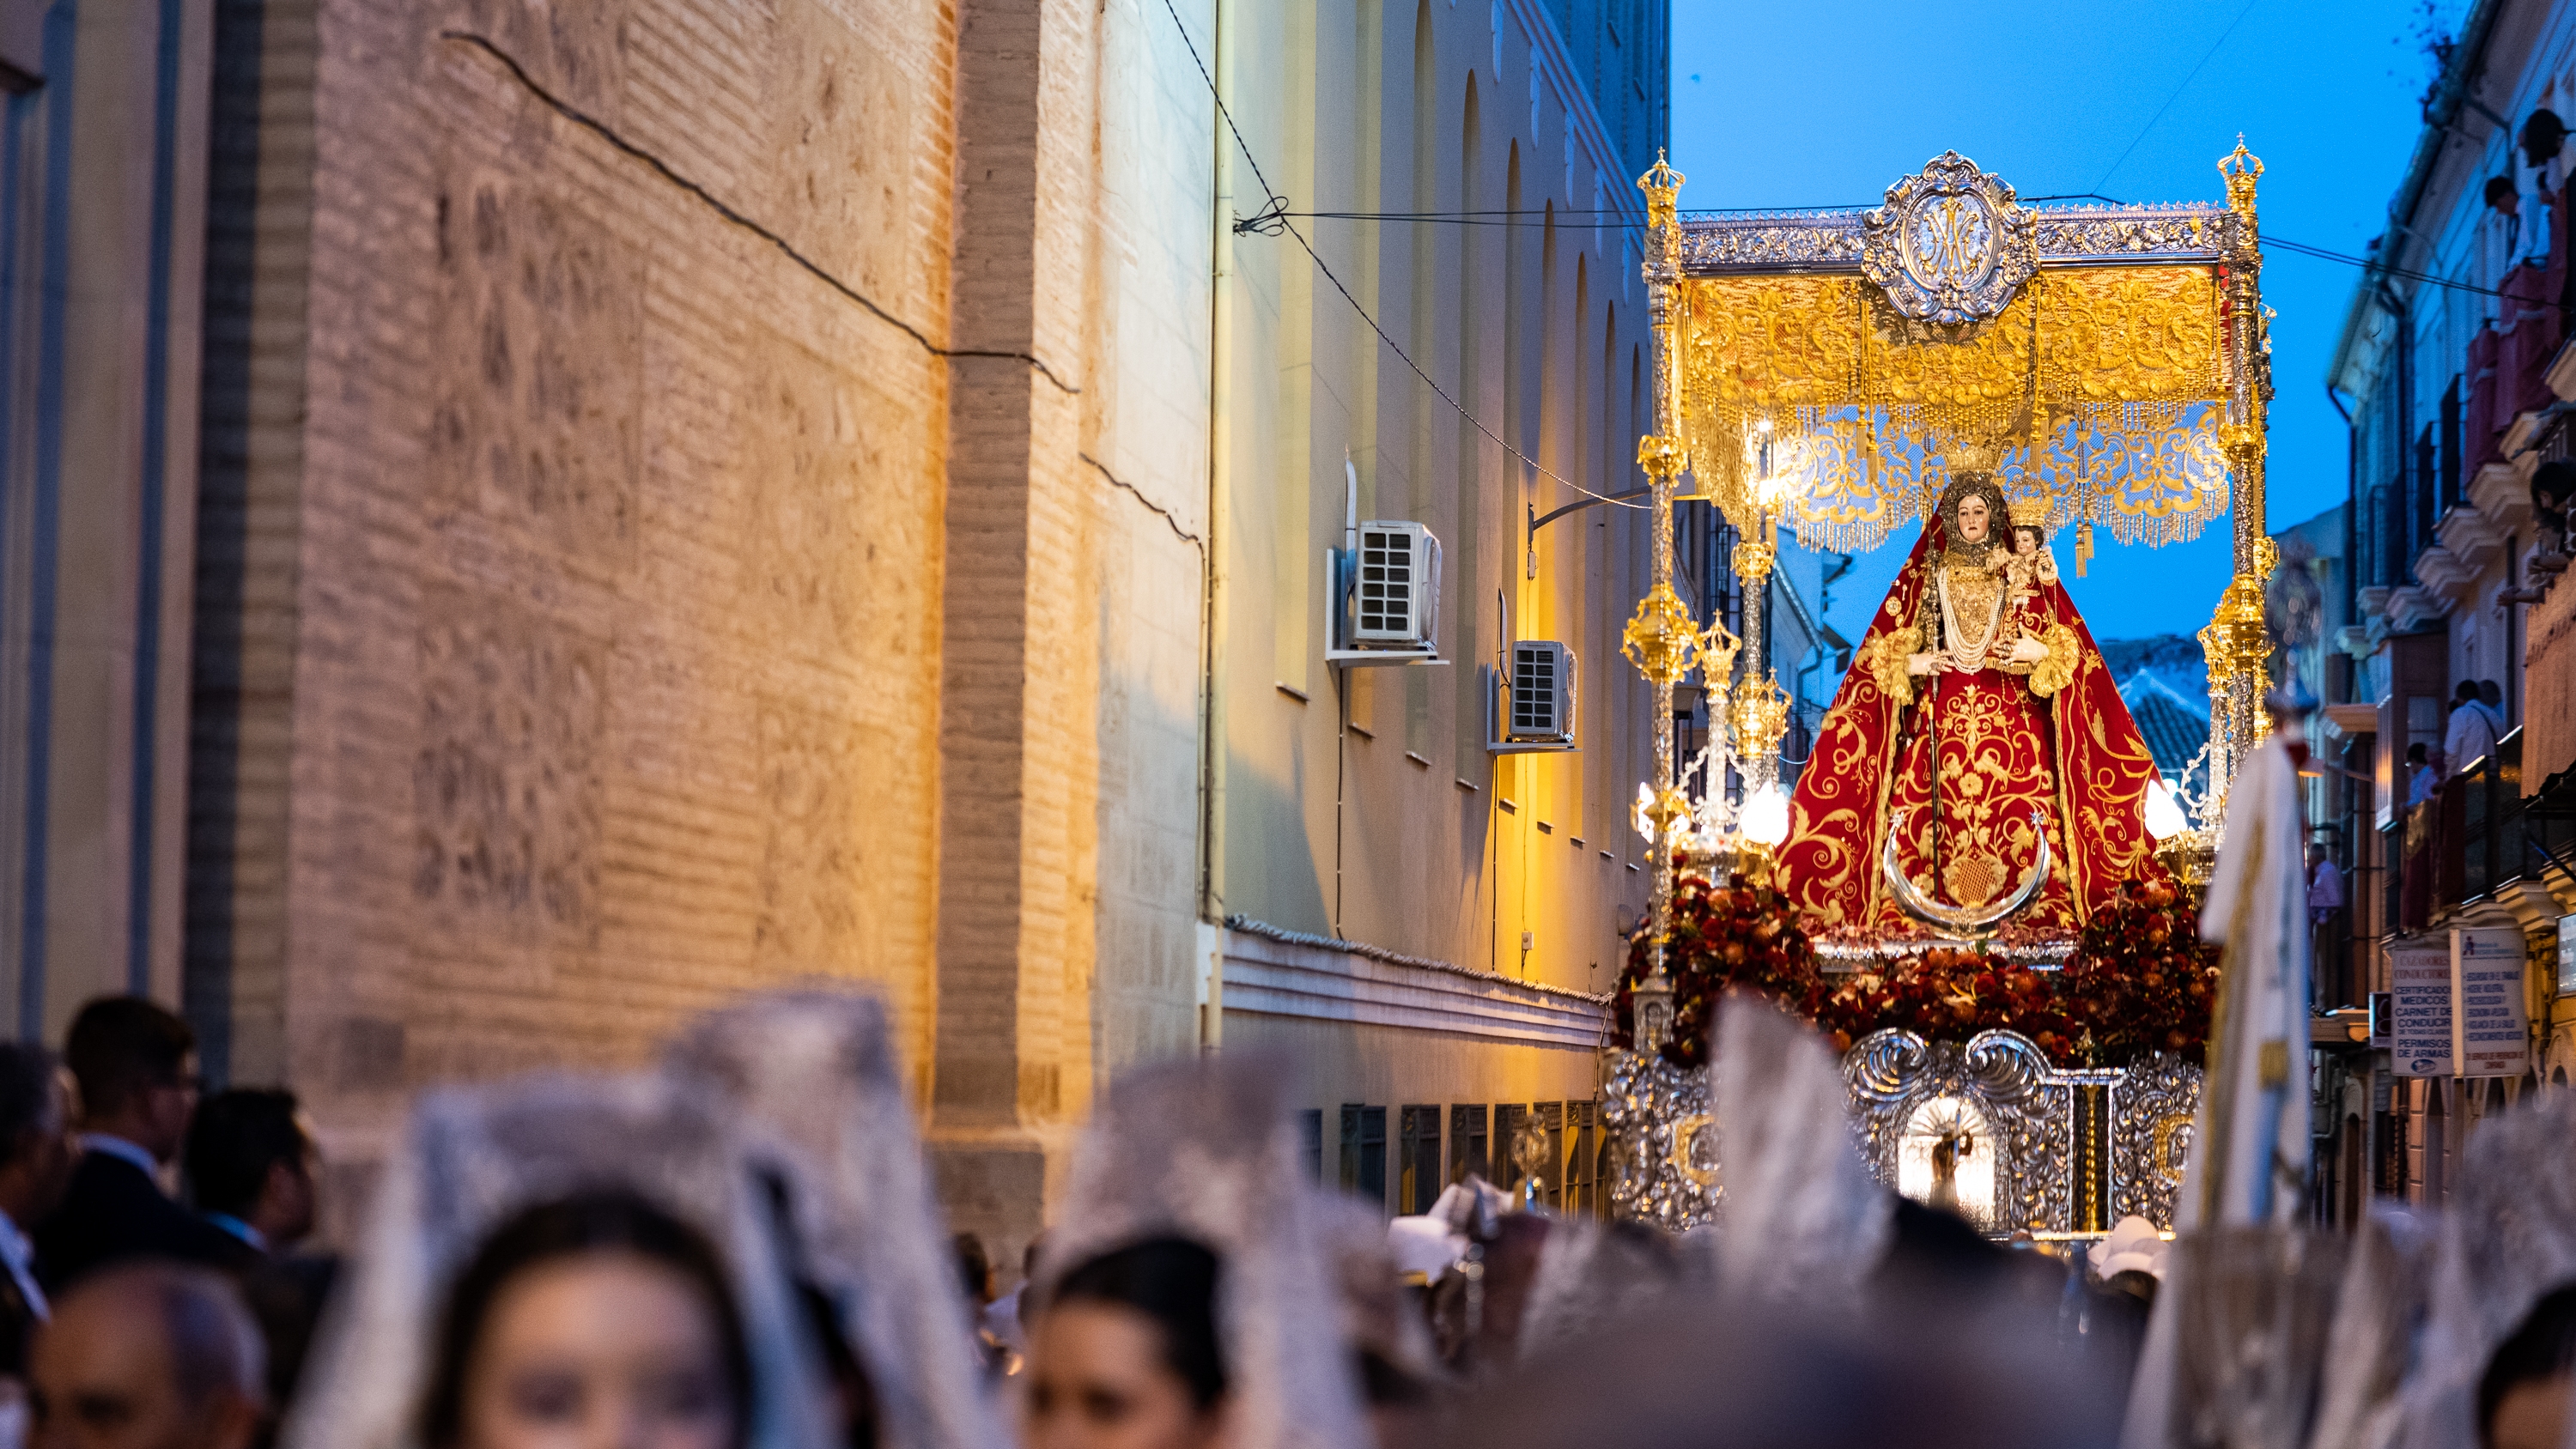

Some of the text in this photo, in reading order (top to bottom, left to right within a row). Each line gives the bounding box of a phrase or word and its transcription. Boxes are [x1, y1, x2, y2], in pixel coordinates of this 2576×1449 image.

[2401, 996, 2448, 1004] MEDICOS
[2395, 1007, 2452, 1016] CARNET DE
[2397, 1018, 2451, 1028] CONDUCIR
[2397, 1039, 2451, 1048] PERMISOS
[2397, 1049, 2451, 1058] DE ARMAS
